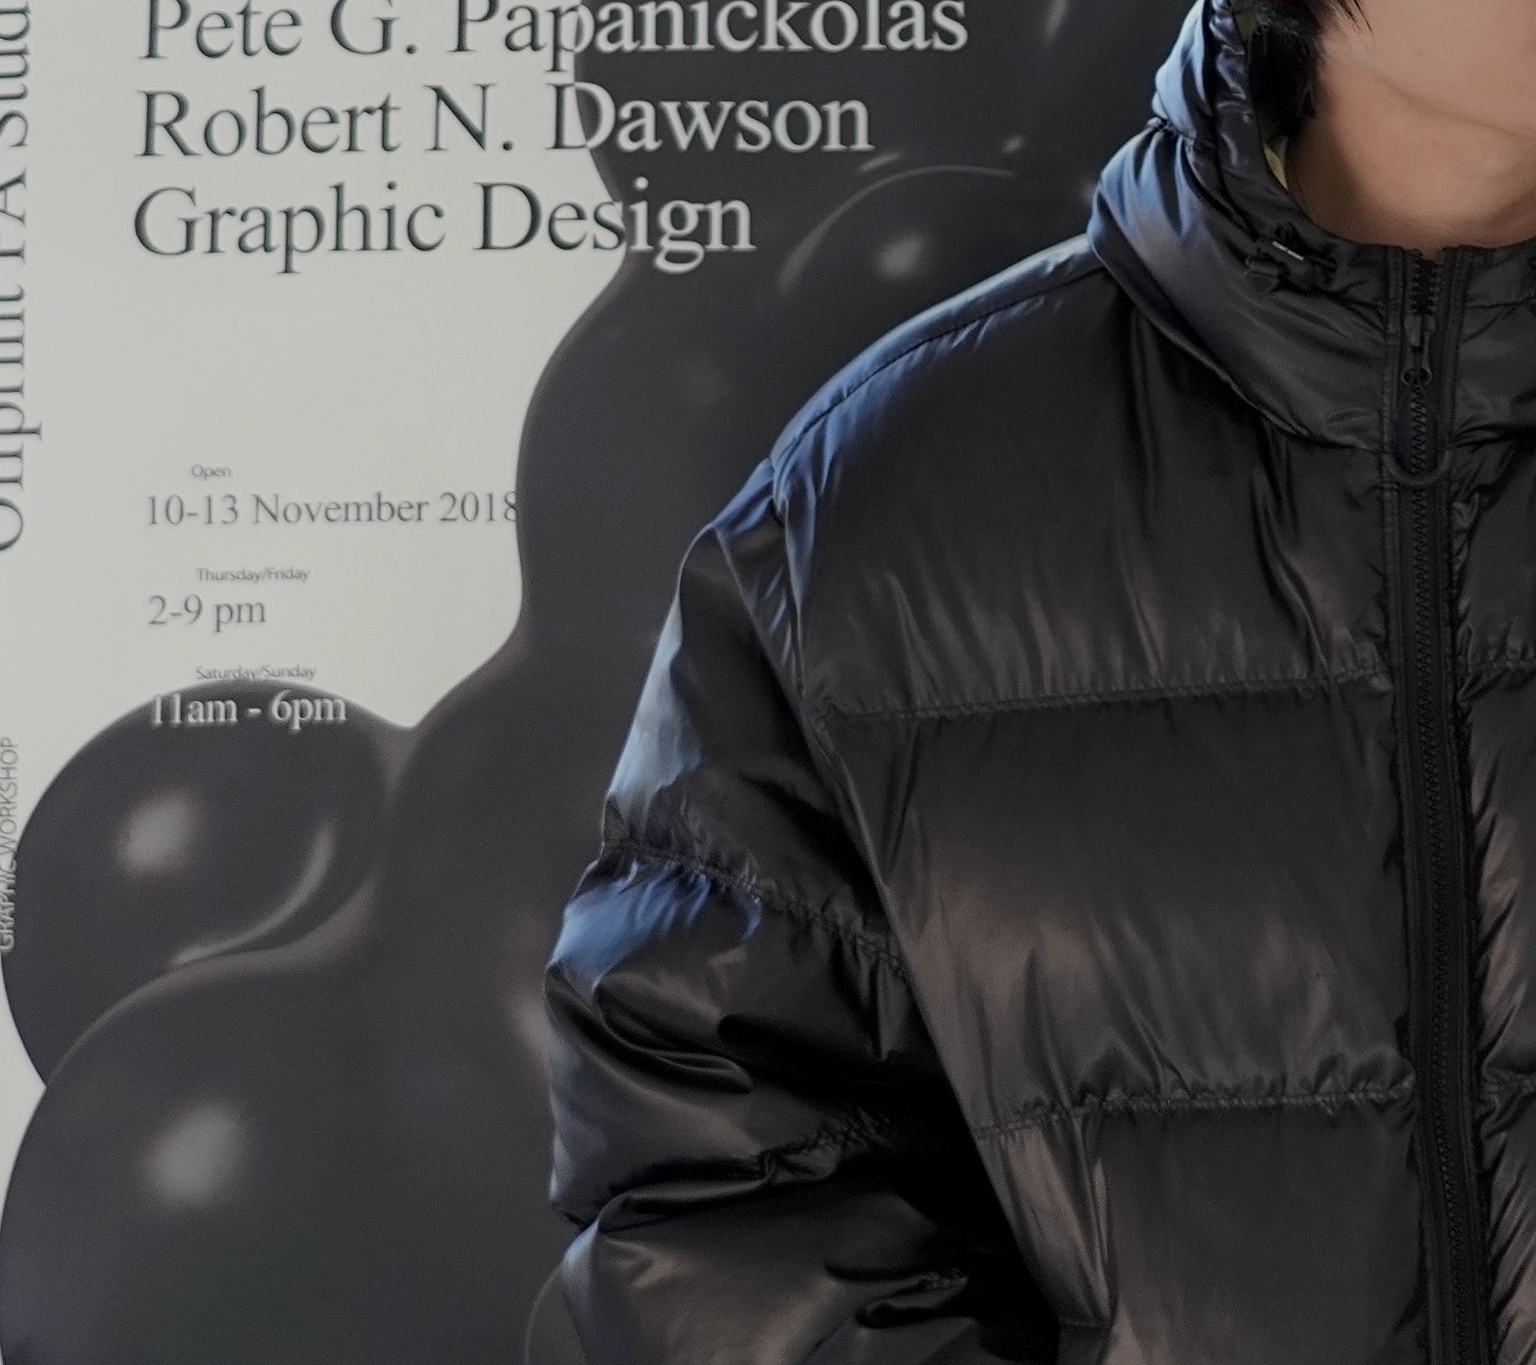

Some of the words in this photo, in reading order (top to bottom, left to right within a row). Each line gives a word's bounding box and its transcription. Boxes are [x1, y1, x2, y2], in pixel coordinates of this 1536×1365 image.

[135, 86, 402, 157] Robert
[425, 83, 513, 152] N.
[546, 79, 874, 151] Dawson
[134, 181, 445, 274] Graphic
[473, 178, 758, 274] Design
[191, 464, 231, 480] Open
[147, 494, 239, 525] 10-13
[251, 492, 430, 524] November
[439, 490, 519, 523] 2018
[196, 567, 310, 583] Thursday/Friday
[148, 594, 202, 626] 2-9
[214, 597, 267, 633] pm
[196, 664, 316, 681] Saturday/Sunday
[152, 691, 239, 726] 11am
[272, 689, 347, 732] 6pm
[0, 736, 19, 854] WORKSHOP
